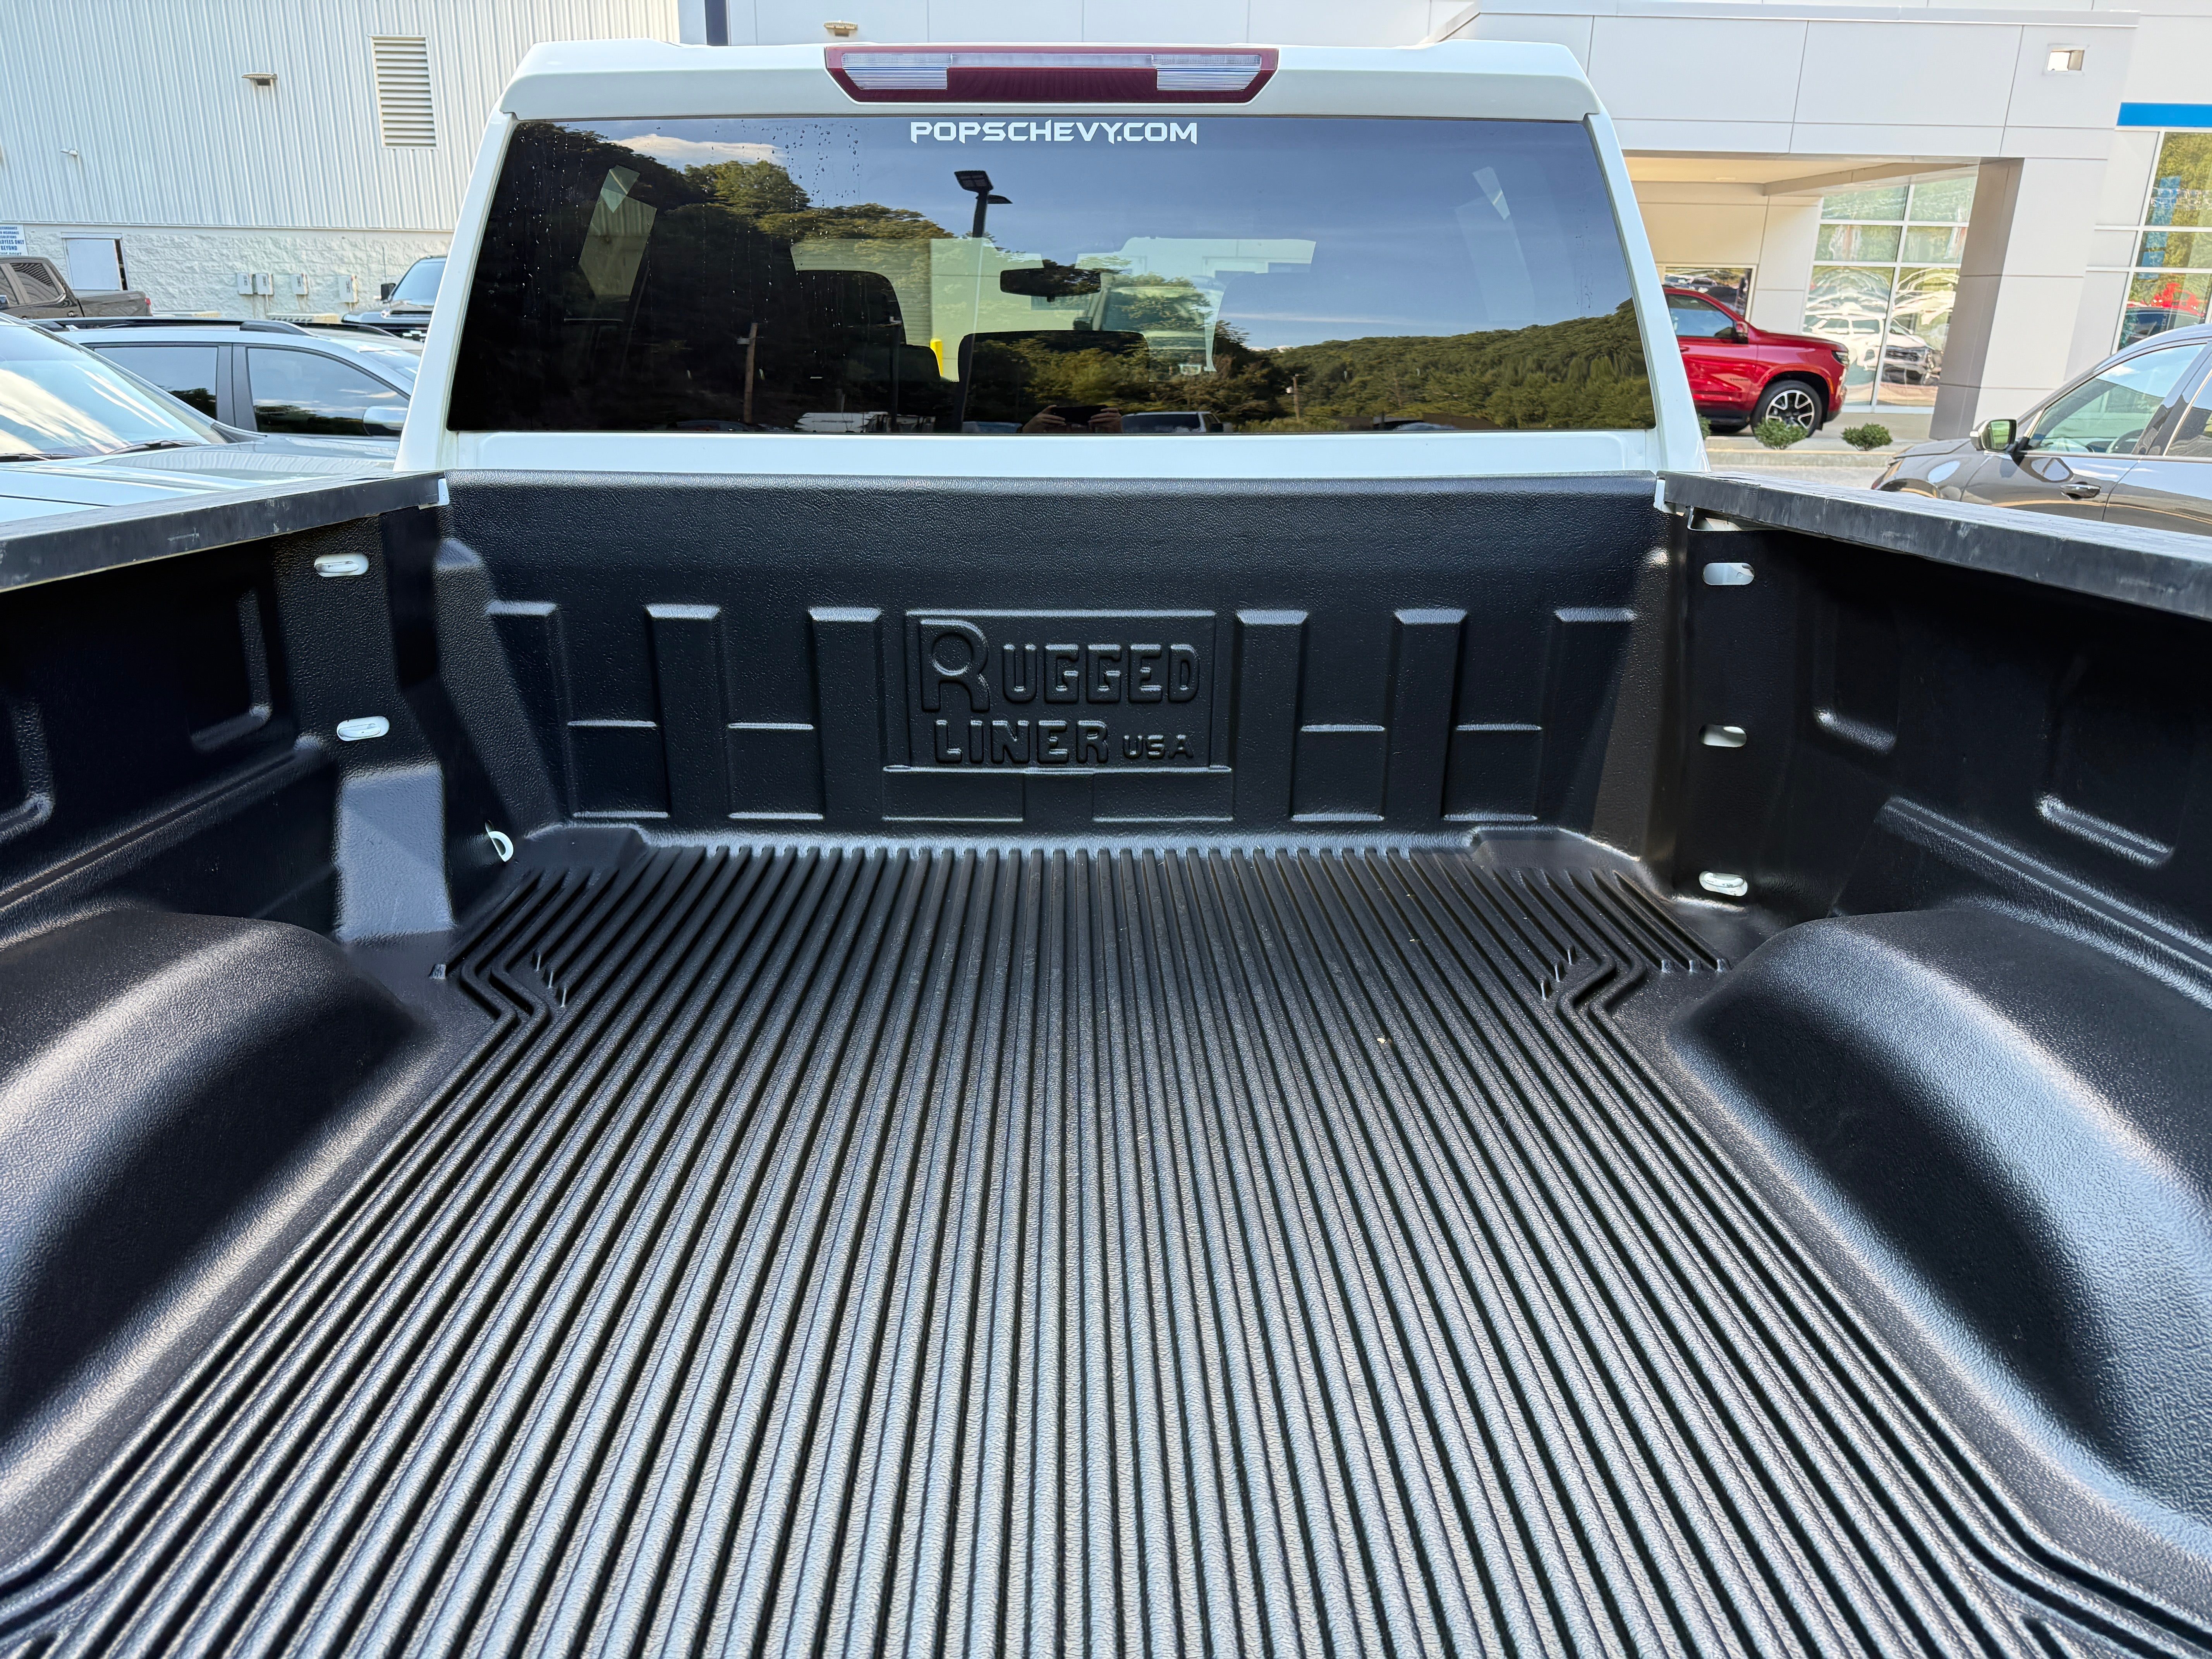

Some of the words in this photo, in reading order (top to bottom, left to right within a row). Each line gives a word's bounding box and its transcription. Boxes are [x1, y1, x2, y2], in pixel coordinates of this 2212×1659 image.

[910, 119, 1197, 145] POPSCHEVY.COM
[919, 619, 1200, 712] RUGGED
[934, 719, 1109, 764] LINER
[1122, 734, 1194, 759] USA
